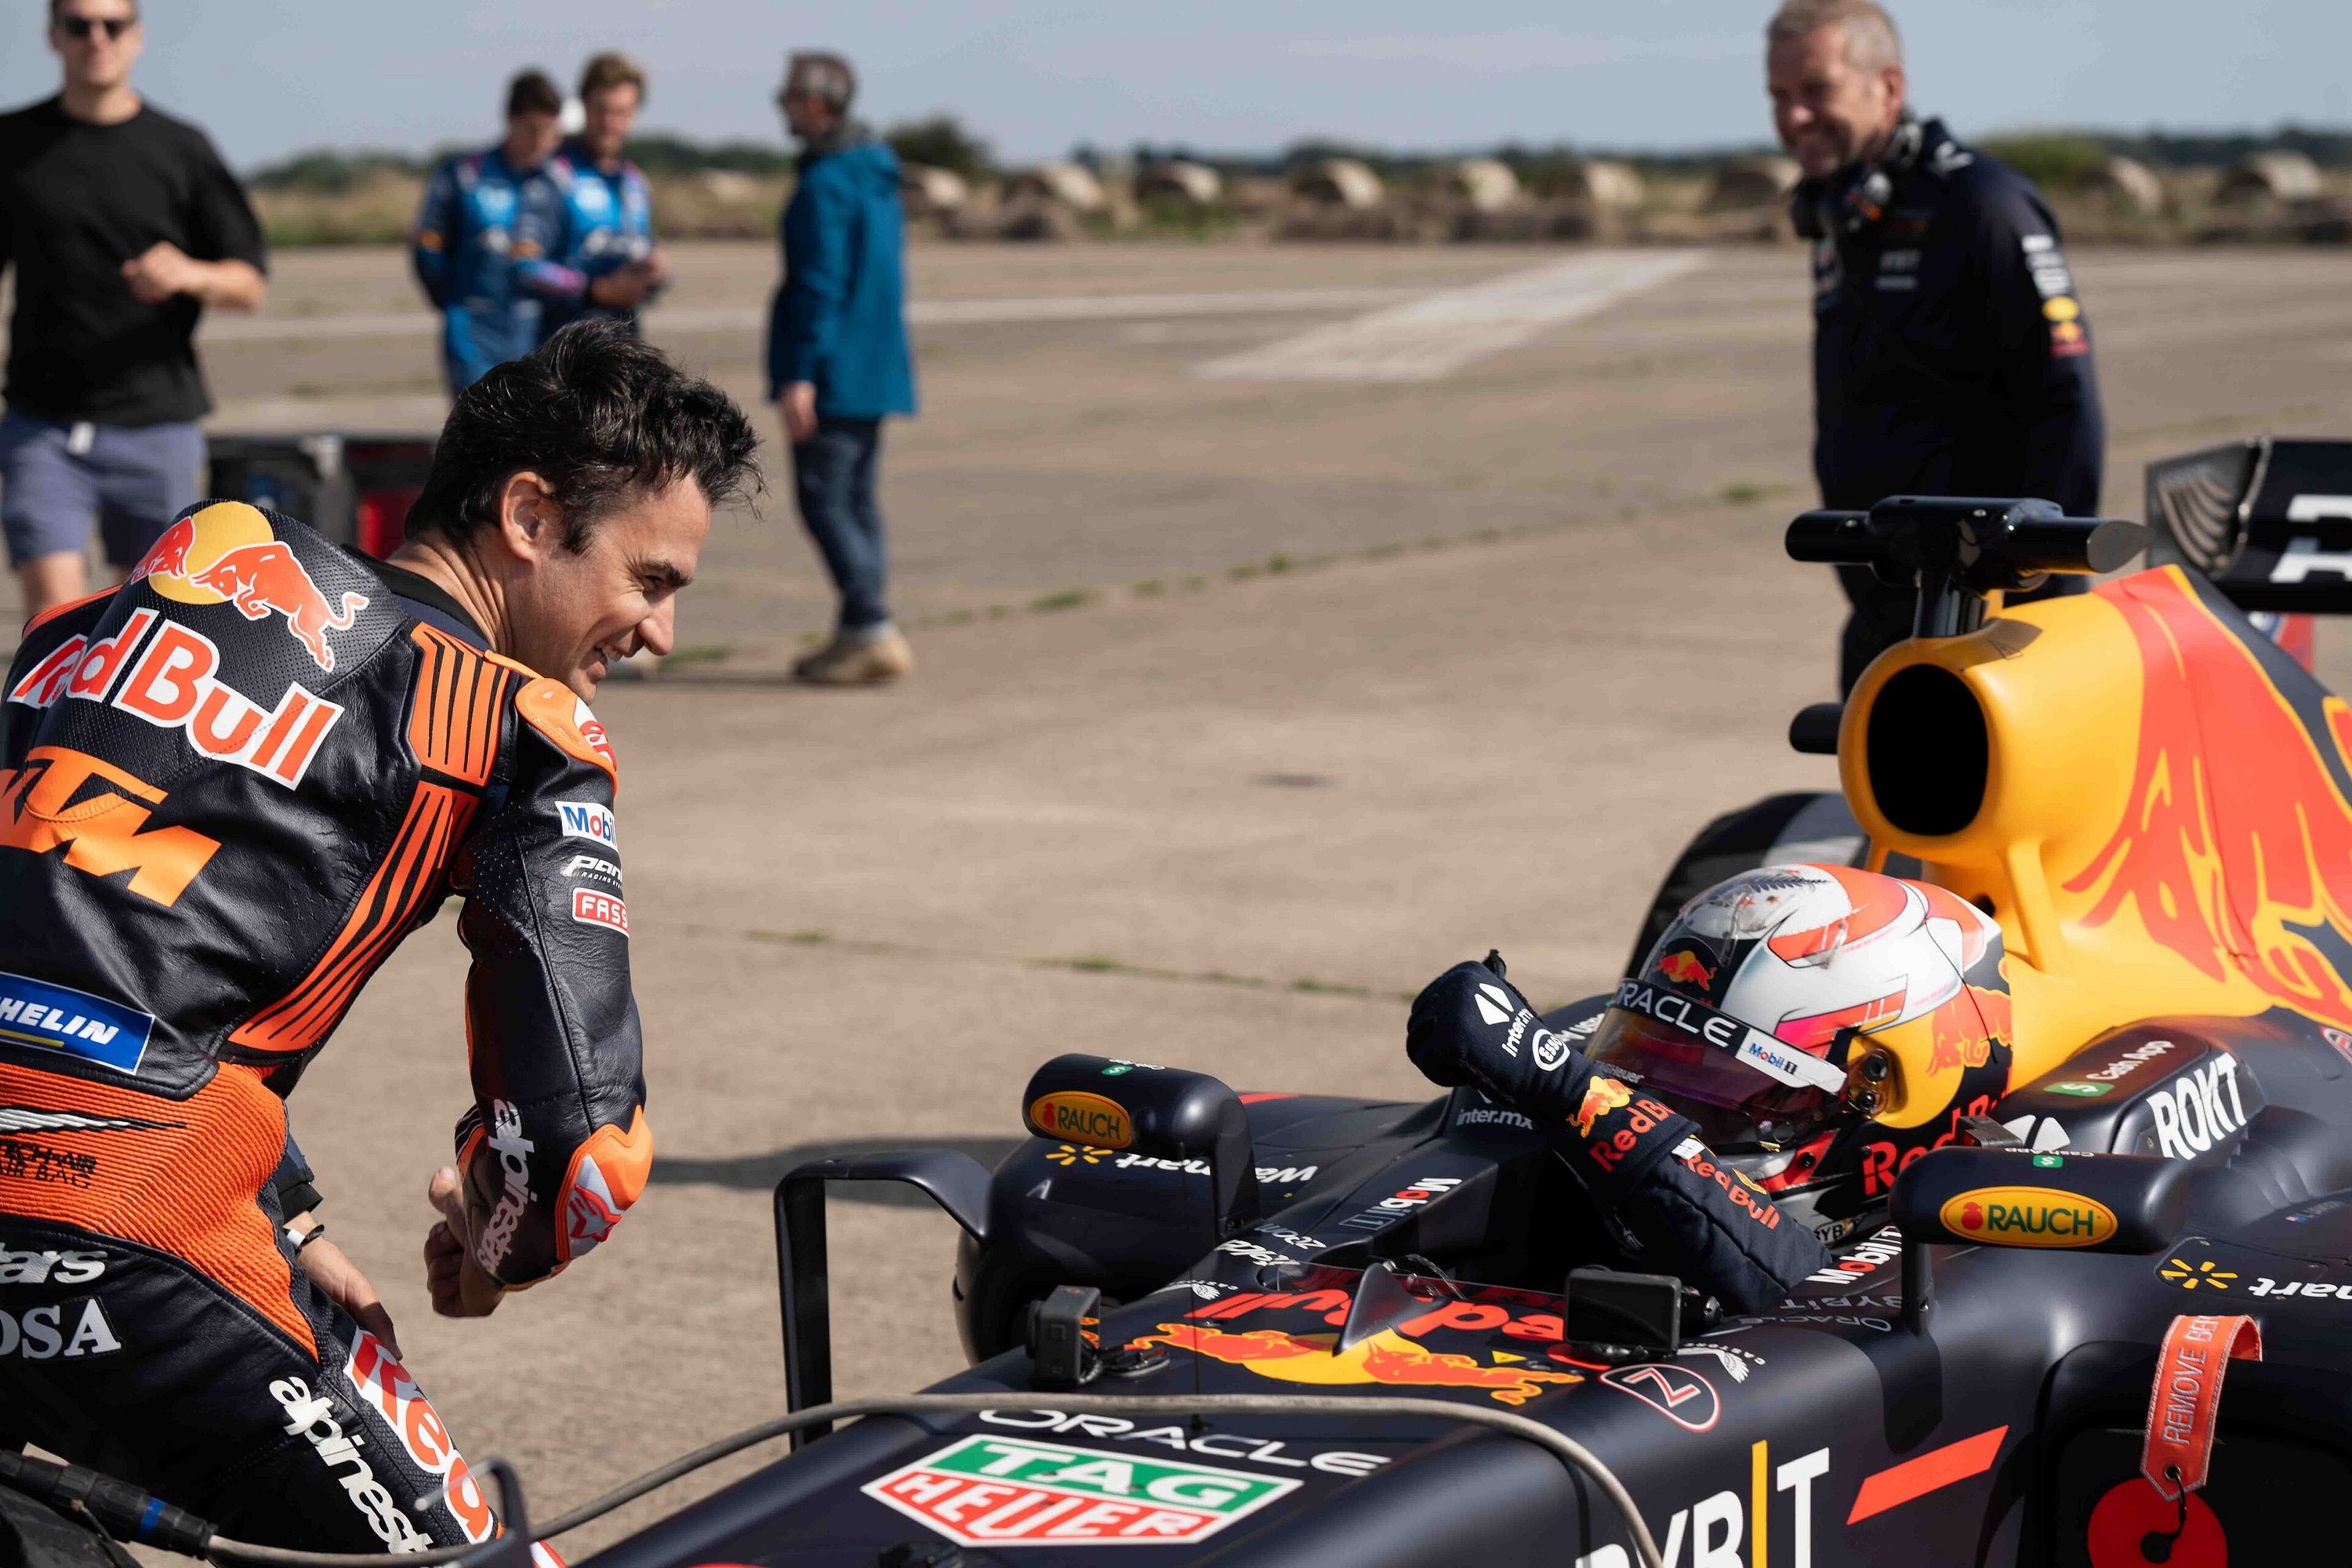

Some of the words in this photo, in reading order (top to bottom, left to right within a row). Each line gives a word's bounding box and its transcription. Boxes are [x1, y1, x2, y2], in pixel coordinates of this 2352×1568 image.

[114, 620, 343, 790] Bull
[1748, 1042, 1785, 1069] Mobil
[1058, 1106, 1121, 1140] RAUCH
[2147, 1051, 2247, 1160] ROKT
[1589, 1105, 1657, 1173] Red
[1365, 1178, 1463, 1217] Mobil
[1729, 1185, 1780, 1229] Bull
[1987, 1205, 2094, 1237] RAUCH
[0, 1242, 108, 1284] ars
[1806, 1241, 1903, 1285] Mobil
[2161, 1346, 2207, 1446] REMOVE
[345, 1328, 495, 1542] Red
[979, 1410, 1392, 1476] ORACLE
[891, 1471, 1208, 1538] HEUER
[978, 1444, 1253, 1510] TAG
[1575, 1439, 1830, 1568] BIT
